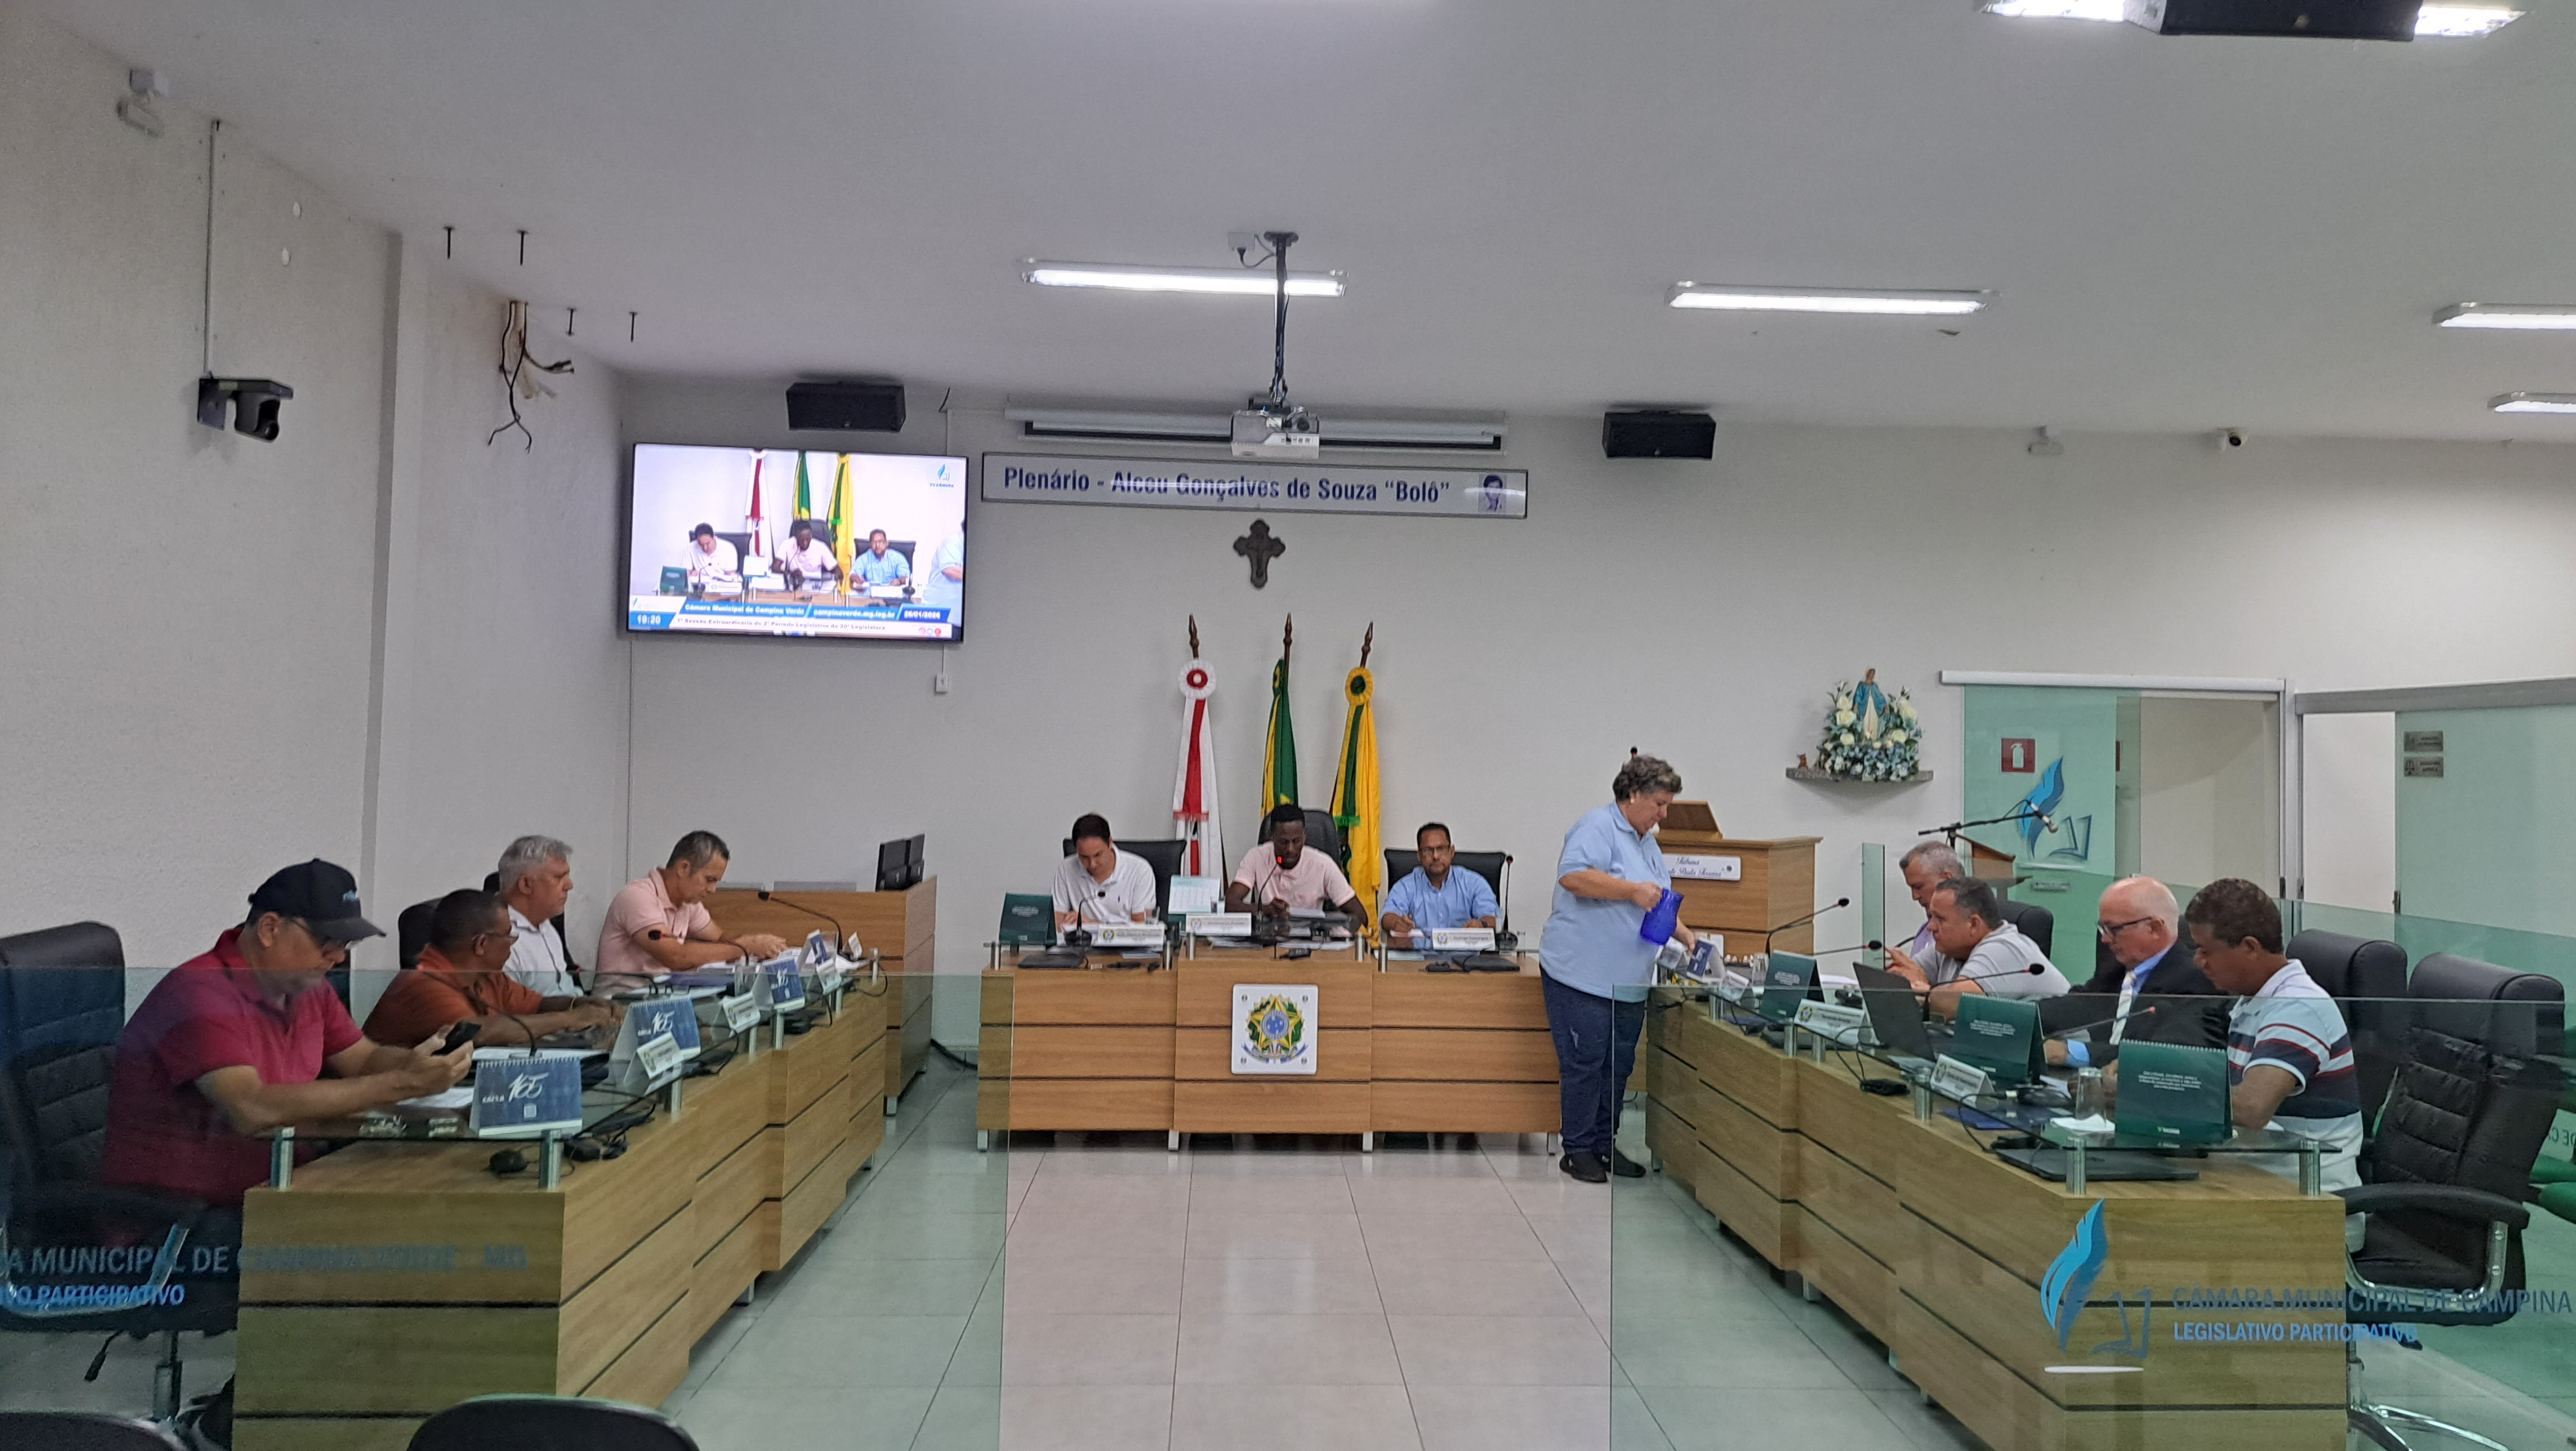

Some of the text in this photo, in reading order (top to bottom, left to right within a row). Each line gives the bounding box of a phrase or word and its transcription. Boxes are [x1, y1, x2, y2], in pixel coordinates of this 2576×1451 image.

[1004, 467, 1090, 492] Plenário
[1112, 471, 1168, 495] Alceu
[1175, 473, 1280, 501] Gonçalves
[1287, 478, 1310, 500] de
[1318, 478, 1378, 501] Souza
[712, 604, 744, 613] Municipal
[755, 606, 784, 615] Campina
[785, 606, 805, 615] Verde
[31, 1245, 186, 1274] MUNICIPL
[192, 1246, 230, 1273] DE
[2173, 1283, 2572, 1313] CÂMARA MUNICIPAL DE CAMPINA
[2174, 1322, 2418, 1343] LEGISLATIVO PARTICIPATIVO
